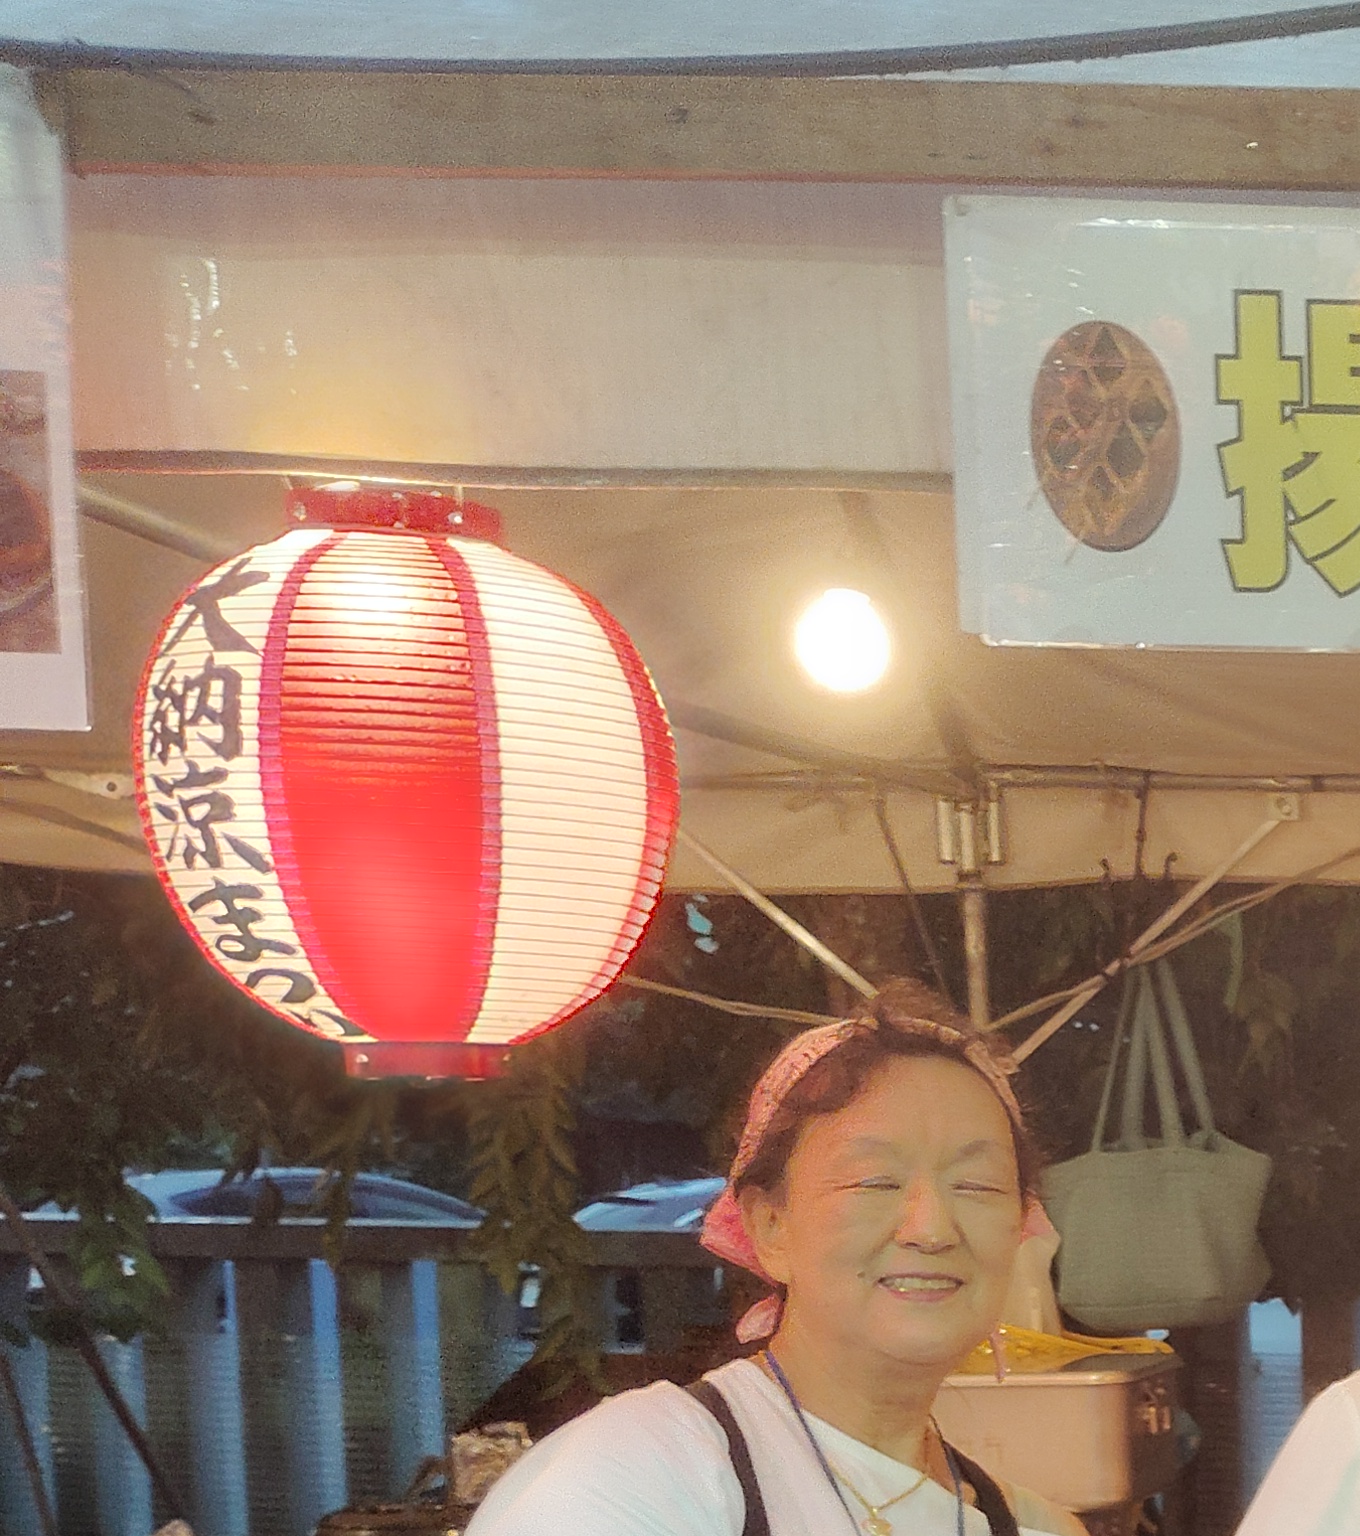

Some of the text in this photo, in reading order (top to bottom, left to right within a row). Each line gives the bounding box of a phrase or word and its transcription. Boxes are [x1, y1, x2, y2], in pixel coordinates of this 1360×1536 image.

[147, 556, 365, 1038] 大納涼まつり
